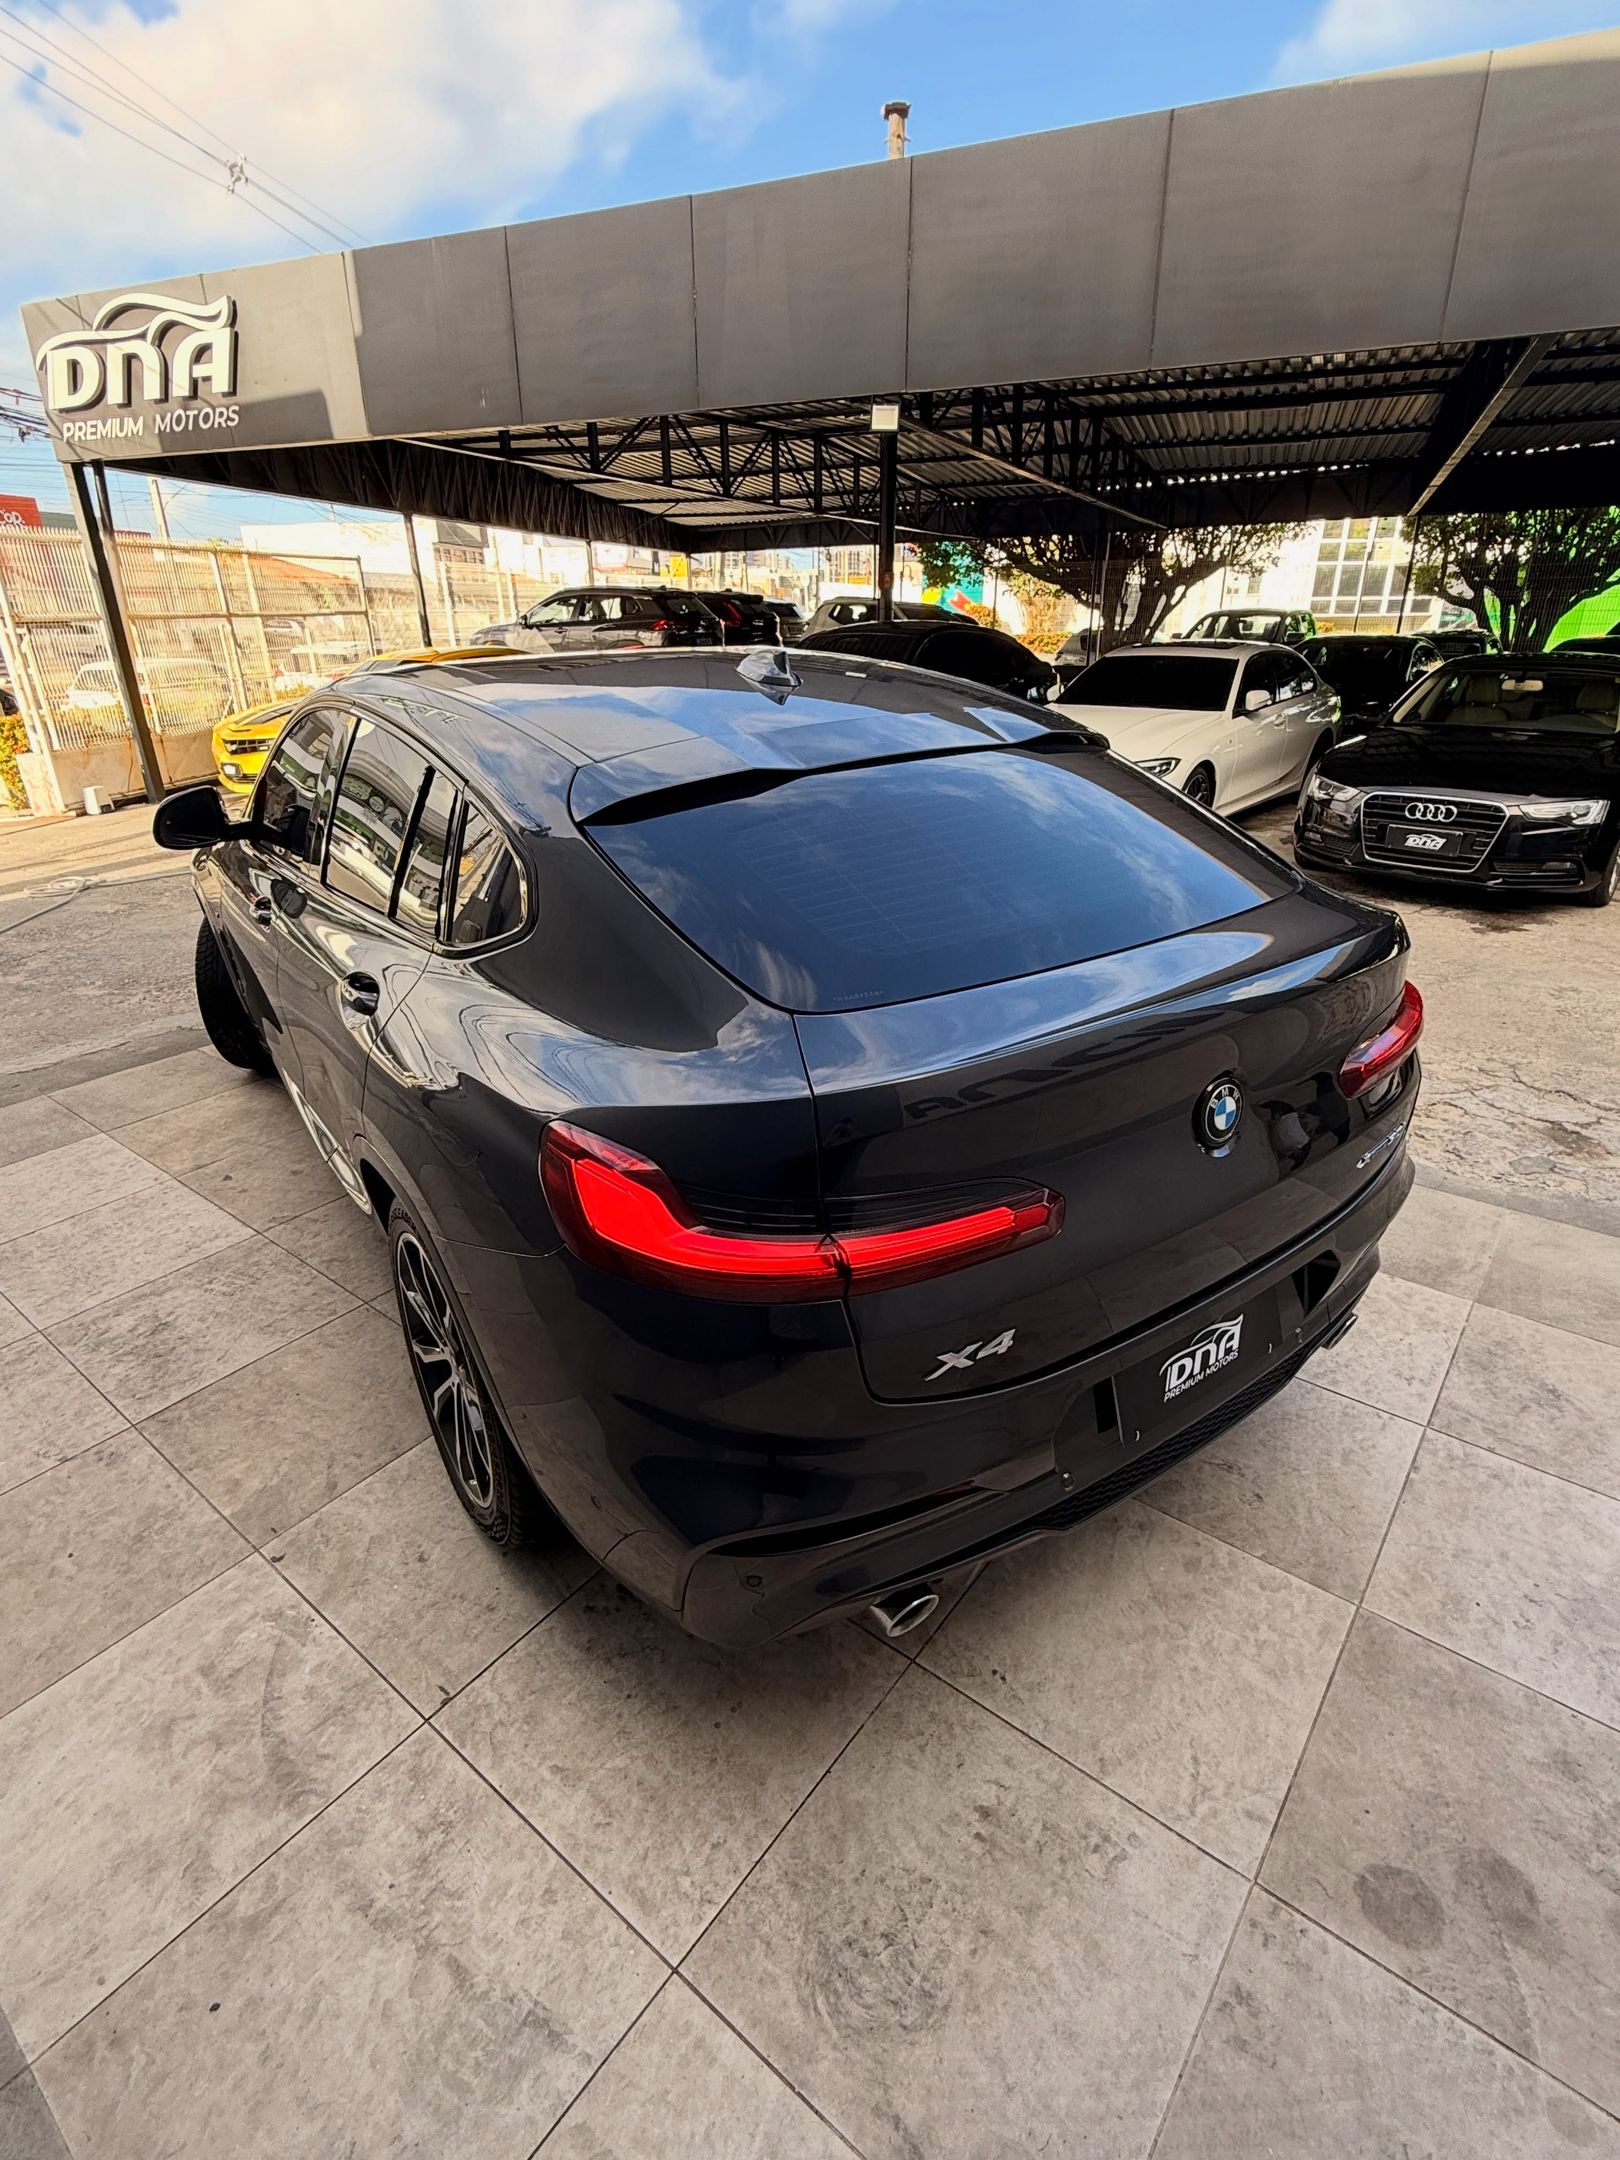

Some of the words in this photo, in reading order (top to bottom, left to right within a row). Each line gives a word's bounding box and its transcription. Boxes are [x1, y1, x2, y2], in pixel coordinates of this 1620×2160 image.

[62, 416, 144, 443] PREMIUM
[154, 404, 240, 434] MOTORS
[1210, 1087, 1240, 1109] BMW
[924, 1328, 1016, 1382] X4
[1163, 1371, 1205, 1404] PREMIUM
[1205, 1348, 1239, 1377] MOTORS
